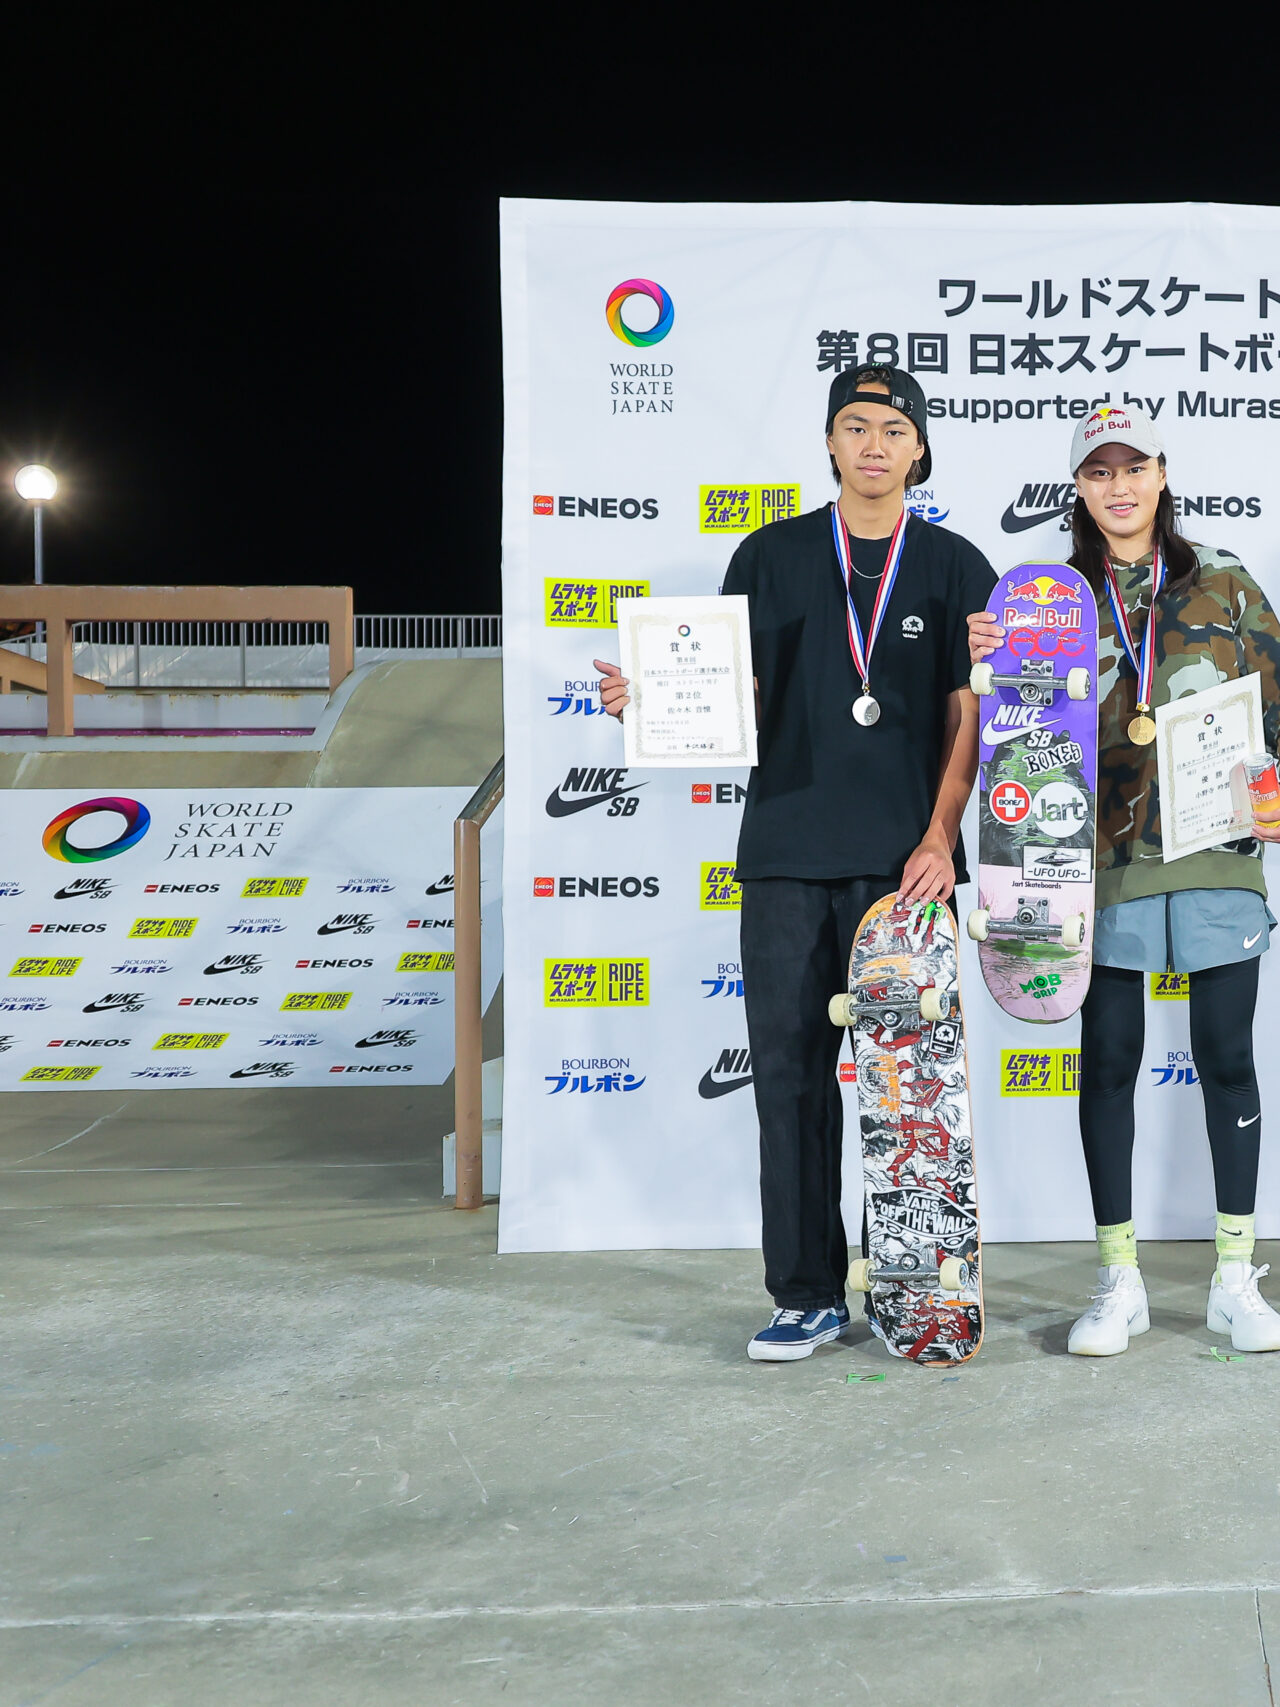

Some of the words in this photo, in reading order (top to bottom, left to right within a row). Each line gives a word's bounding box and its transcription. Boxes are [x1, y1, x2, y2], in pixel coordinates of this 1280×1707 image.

[815, 330, 949, 375] 第8回
[609, 363, 674, 377] WORLD
[610, 381, 674, 395] SKATE
[611, 399, 674, 416] JAPAN
[1084, 422, 1104, 441] Red
[1108, 420, 1131, 430] Bull
[761, 488, 796, 508] RIDE
[1016, 483, 1078, 508] NIKE
[558, 495, 659, 520] ENEOS
[1003, 607, 1042, 627] Red
[1043, 607, 1081, 627] Bull
[993, 704, 1046, 727] NIKE
[1026, 729, 1054, 748] SB
[1024, 742, 1082, 775] BONES
[561, 767, 629, 793] NIKE
[186, 801, 293, 818] WORLD
[606, 797, 640, 817] SB
[1033, 797, 1087, 823] Jart
[174, 821, 285, 838] SKATE
[163, 842, 278, 862] JAPAN
[67, 878, 113, 890] NIKE
[158, 883, 221, 894] ENEOS
[279, 887, 303, 896] LIFE
[558, 876, 660, 898] ENEOS
[1011, 880, 1024, 888] Jart
[1025, 881, 1062, 890] Skateboards
[89, 890, 113, 900] SB
[43, 923, 108, 934] ENEOS
[329, 913, 374, 925] NIKE
[352, 925, 376, 935] SB
[310, 958, 374, 969] ENEOS
[608, 962, 645, 982] RIDE
[608, 982, 645, 1002] LIFE
[1019, 973, 1062, 995] MOB
[1032, 986, 1058, 999] GRIP
[192, 996, 260, 1006] ENEOS
[62, 1038, 132, 1048] ENEOS
[561, 1057, 631, 1070] BOURBON
[544, 1071, 647, 1095] ブルボン
[901, 1190, 939, 1212] VANS
[904, 1205, 931, 1232] THE
